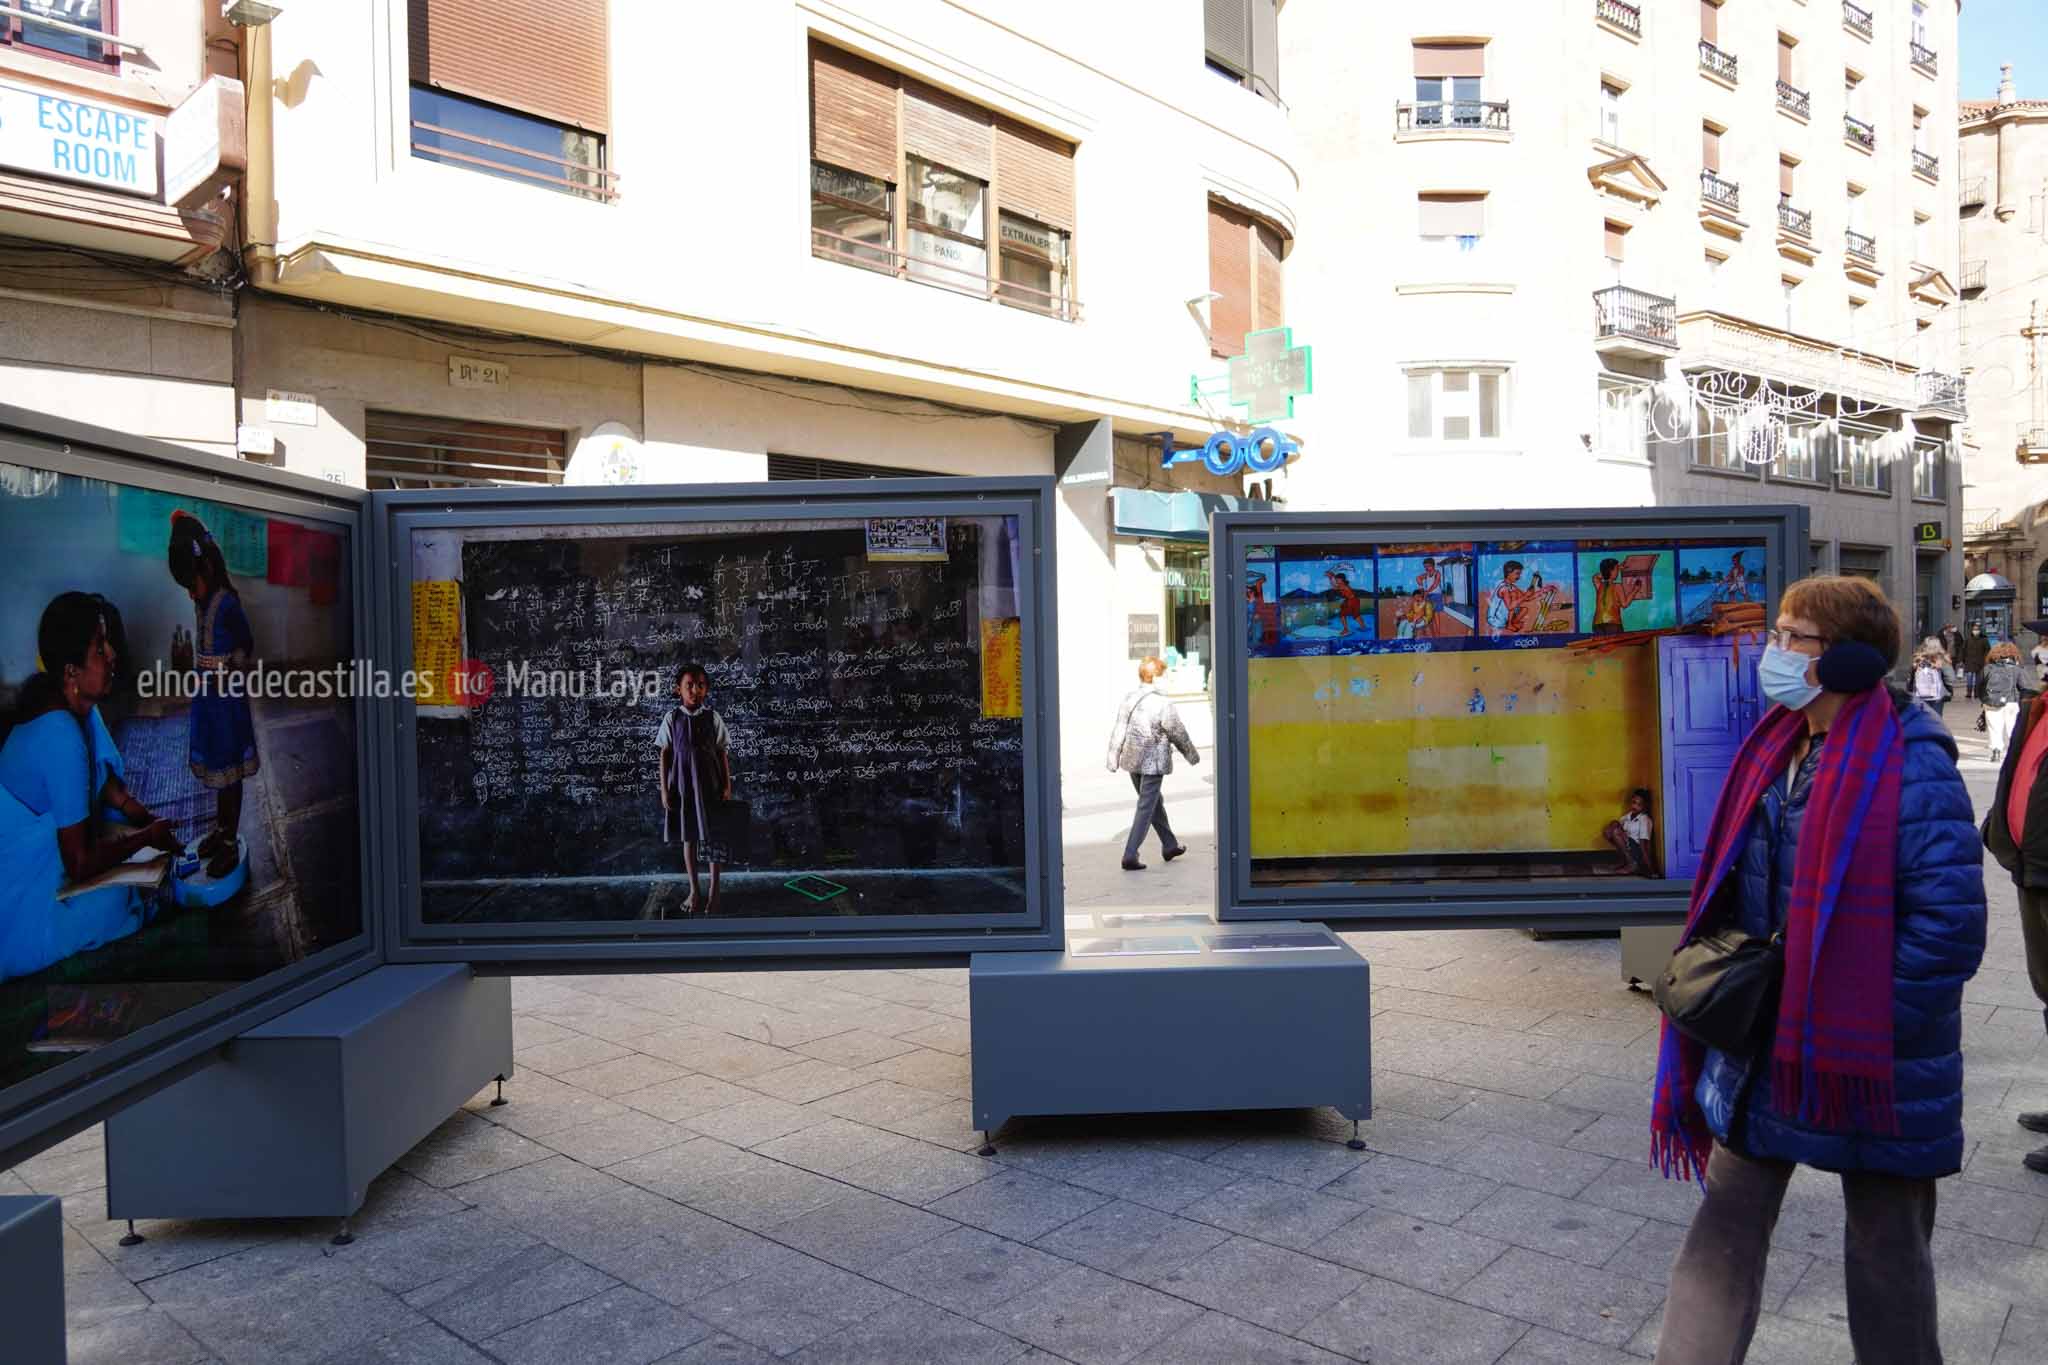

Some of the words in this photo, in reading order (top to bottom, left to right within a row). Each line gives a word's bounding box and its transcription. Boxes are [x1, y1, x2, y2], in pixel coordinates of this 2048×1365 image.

[38, 96, 148, 149] ESCAPE
[54, 138, 137, 184] ROOM
[483, 367, 500, 384] 21
